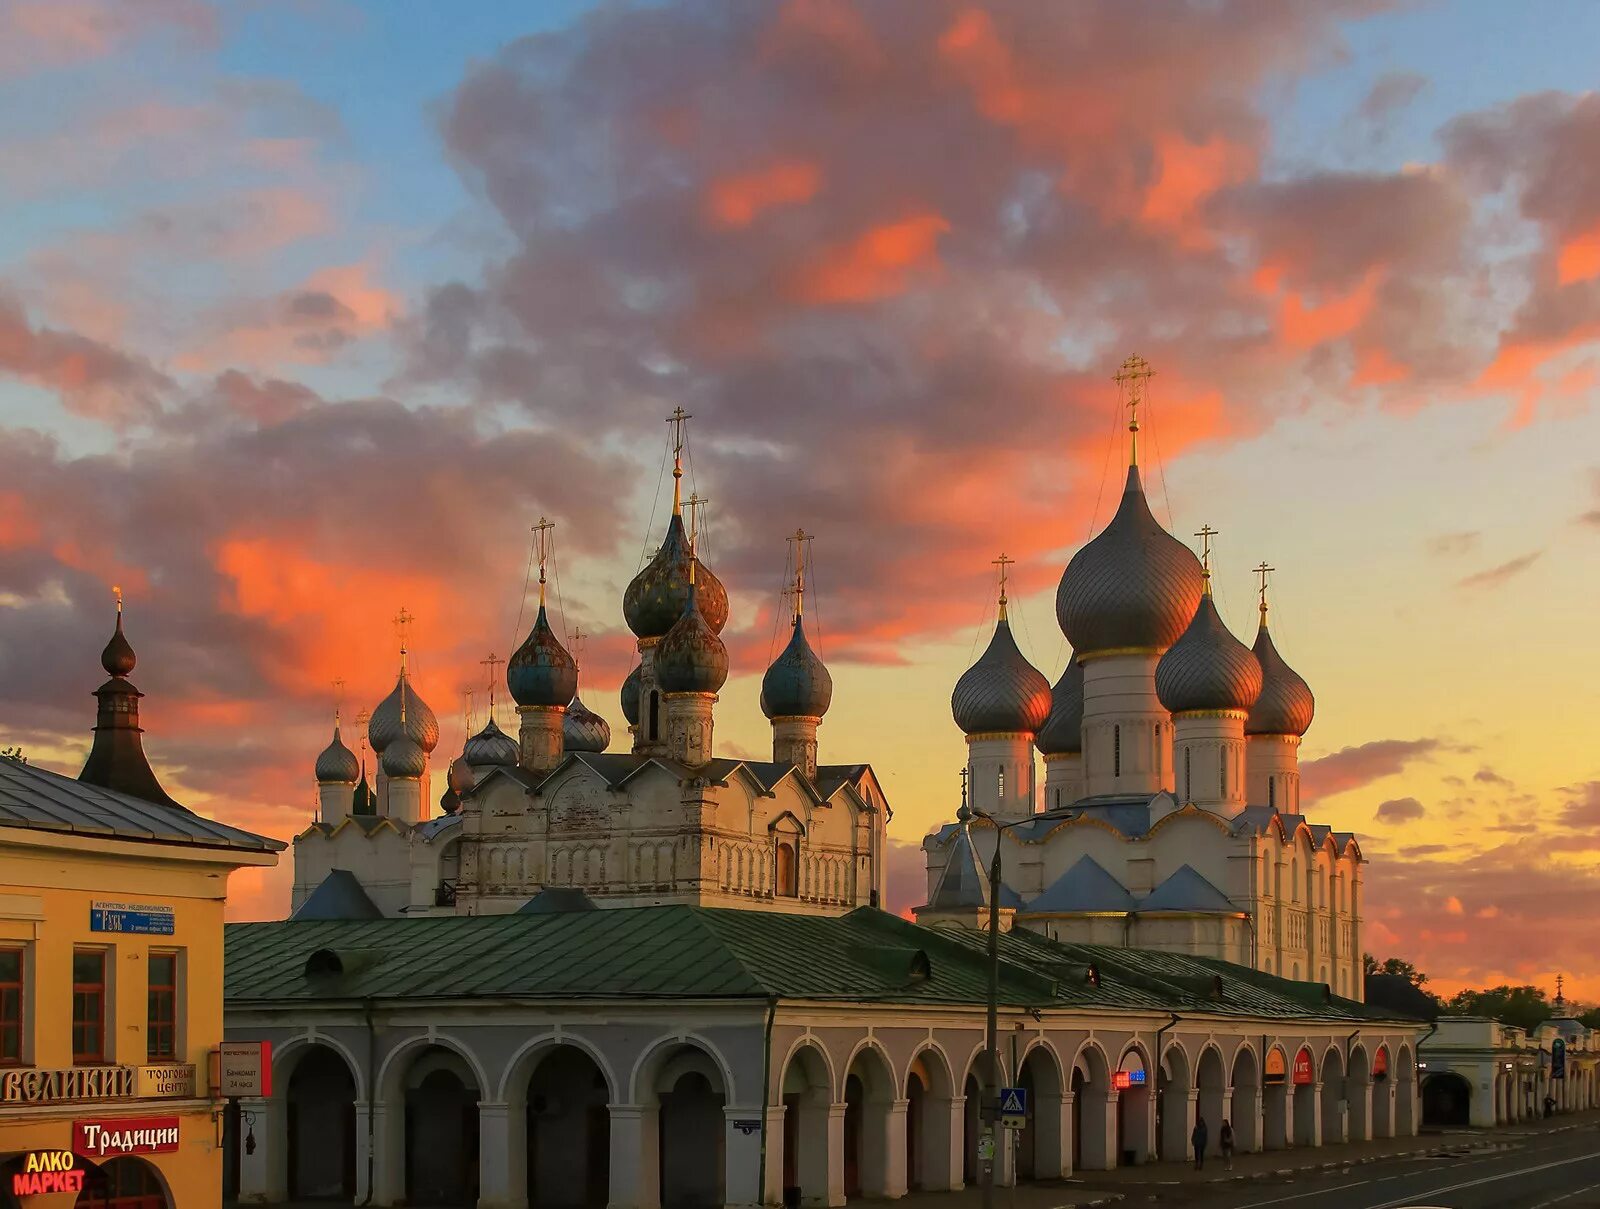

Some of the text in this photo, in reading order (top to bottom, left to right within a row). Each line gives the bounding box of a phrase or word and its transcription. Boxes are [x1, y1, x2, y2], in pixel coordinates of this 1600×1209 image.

[95, 902, 126, 910] АГЕНТСТВО
[2, 1066, 135, 1102] ВЕЛИКИЙ
[84, 1124, 179, 1155] Традиции
[27, 1151, 74, 1173] АЛКО
[13, 1170, 85, 1196] МАРКЕТ
